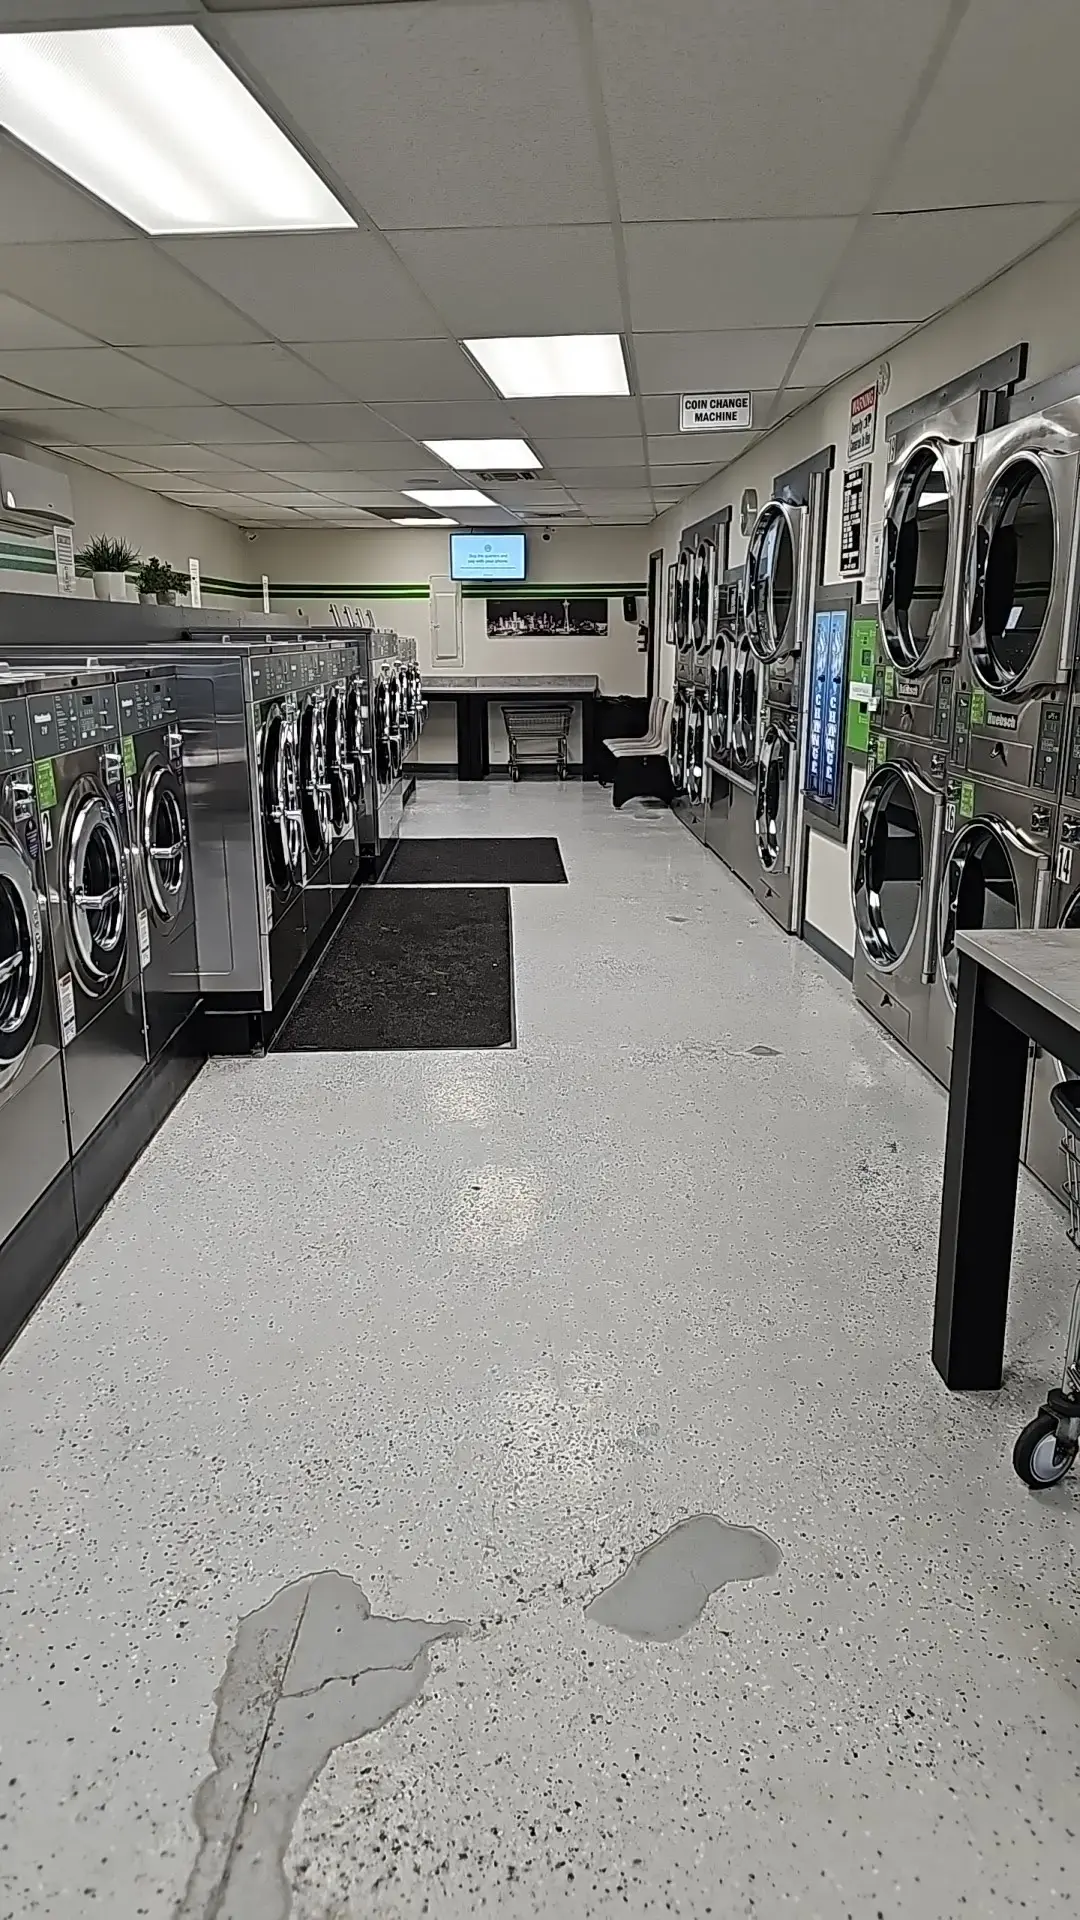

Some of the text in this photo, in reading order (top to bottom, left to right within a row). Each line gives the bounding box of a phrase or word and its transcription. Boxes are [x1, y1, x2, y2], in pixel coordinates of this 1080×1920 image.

[685, 398, 748, 410] COIN CHANGE
[852, 390, 874, 414] WARNING
[694, 411, 738, 422] MACHINE
[987, 711, 1016, 729] Huebsch
[825, 696, 837, 780] CHANGE
[43, 812, 52, 848] 2
[946, 804, 955, 832] 16
[1058, 847, 1071, 882] 14
